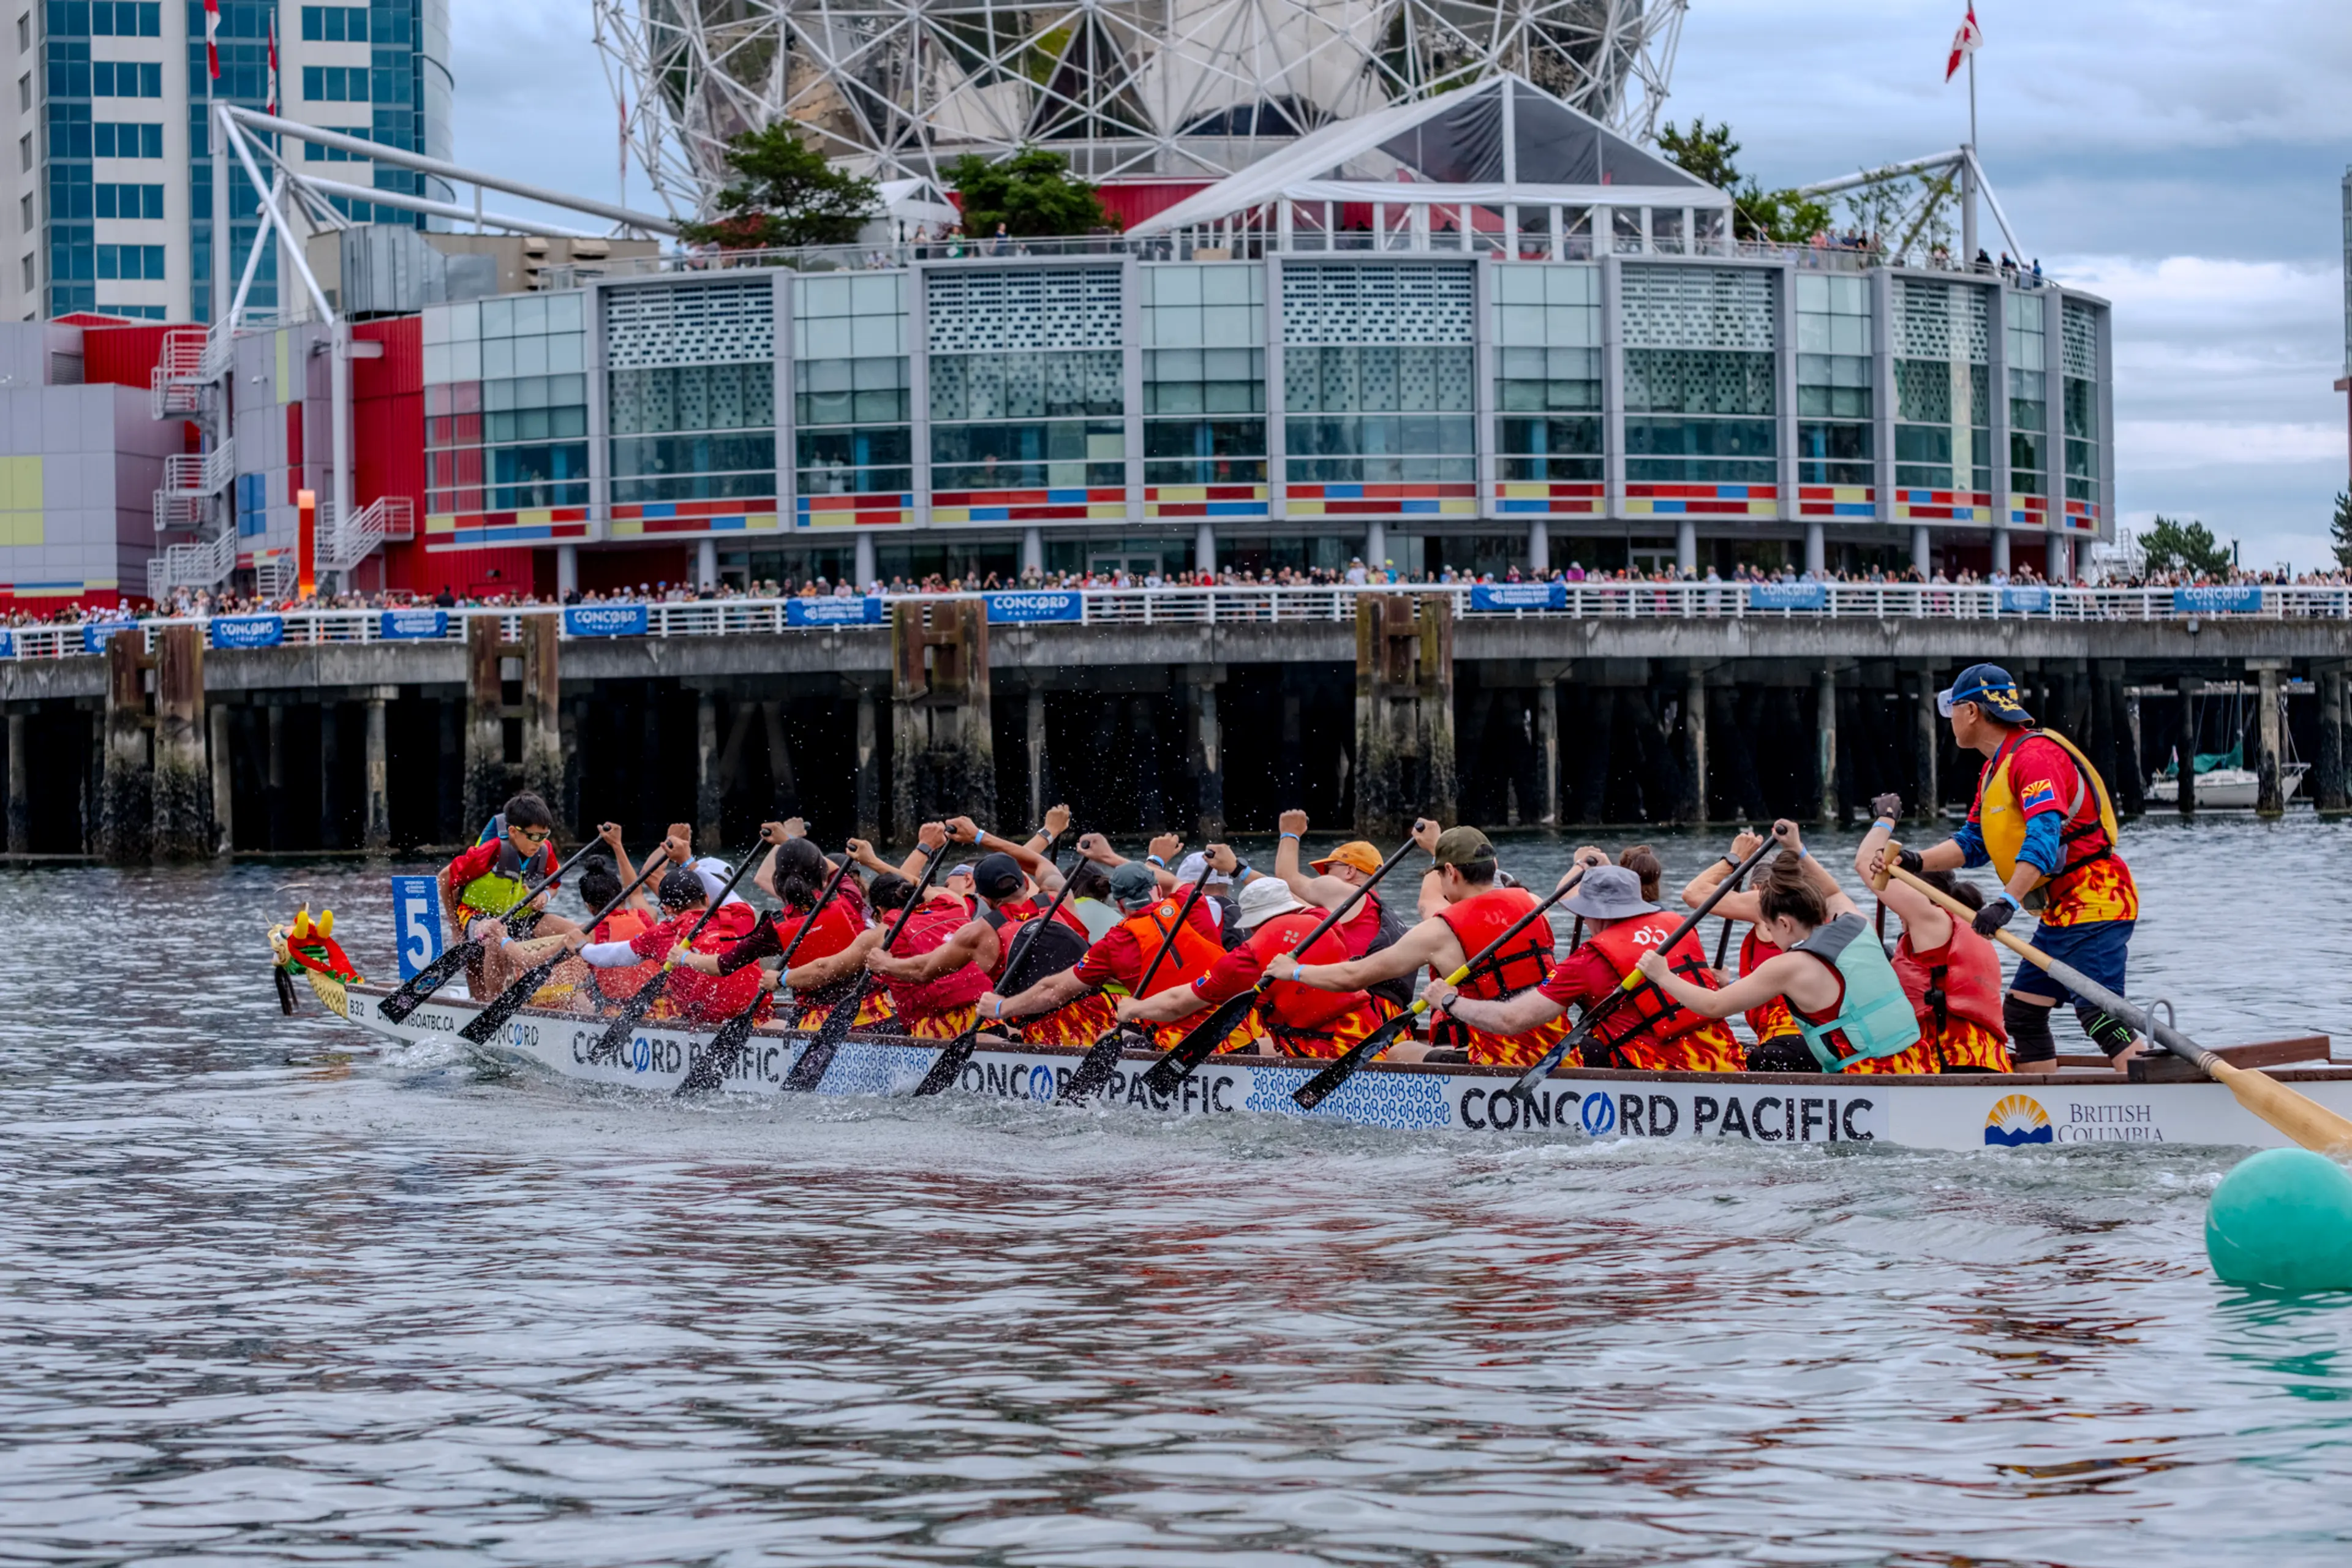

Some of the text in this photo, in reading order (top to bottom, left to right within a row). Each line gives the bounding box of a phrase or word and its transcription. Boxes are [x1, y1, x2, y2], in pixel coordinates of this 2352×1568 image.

[993, 596, 1070, 609] CONCORD
[2184, 587, 2250, 600] CONCORD
[574, 611, 637, 624] CONCORD
[221, 621, 274, 636] CONCORD
[405, 899, 432, 971] 5
[350, 999, 364, 1017] B32
[377, 1008, 455, 1032] DNBOATBC.CA
[490, 1022, 539, 1047] NCORD
[1460, 1087, 1874, 1142] CONCORD PACIFIC
[2070, 1103, 2152, 1123] BRITISH
